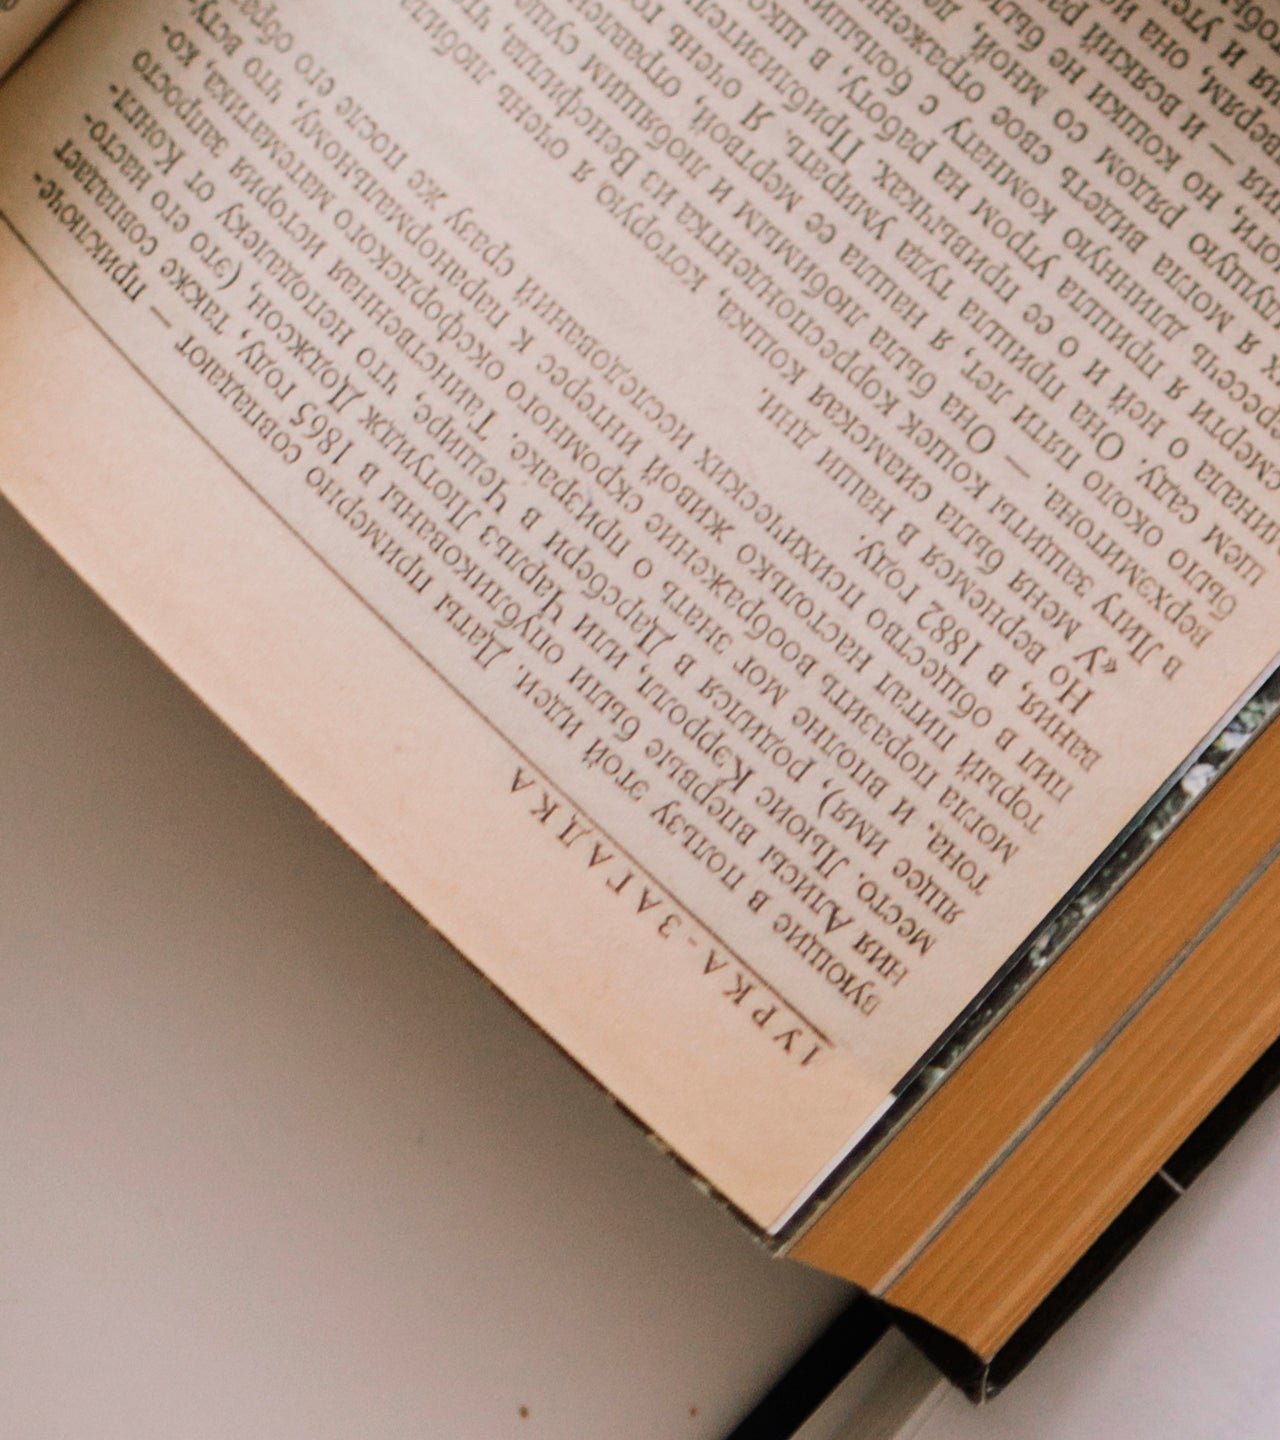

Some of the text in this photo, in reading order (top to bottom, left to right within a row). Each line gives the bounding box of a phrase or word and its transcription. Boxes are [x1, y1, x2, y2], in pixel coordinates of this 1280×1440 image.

[916, 92, 941, 117] с
[940, 115, 1059, 227] комнату
[287, 400, 356, 467] 1865
[518, 505, 545, 533] в
[756, 385, 1097, 717] Но вернемся в наши дни.
[540, 527, 679, 659] Дарсбери
[672, 652, 698, 680] в
[915, 598, 986, 668] 1882
[985, 660, 1012, 689] в
[694, 673, 819, 785] родился
